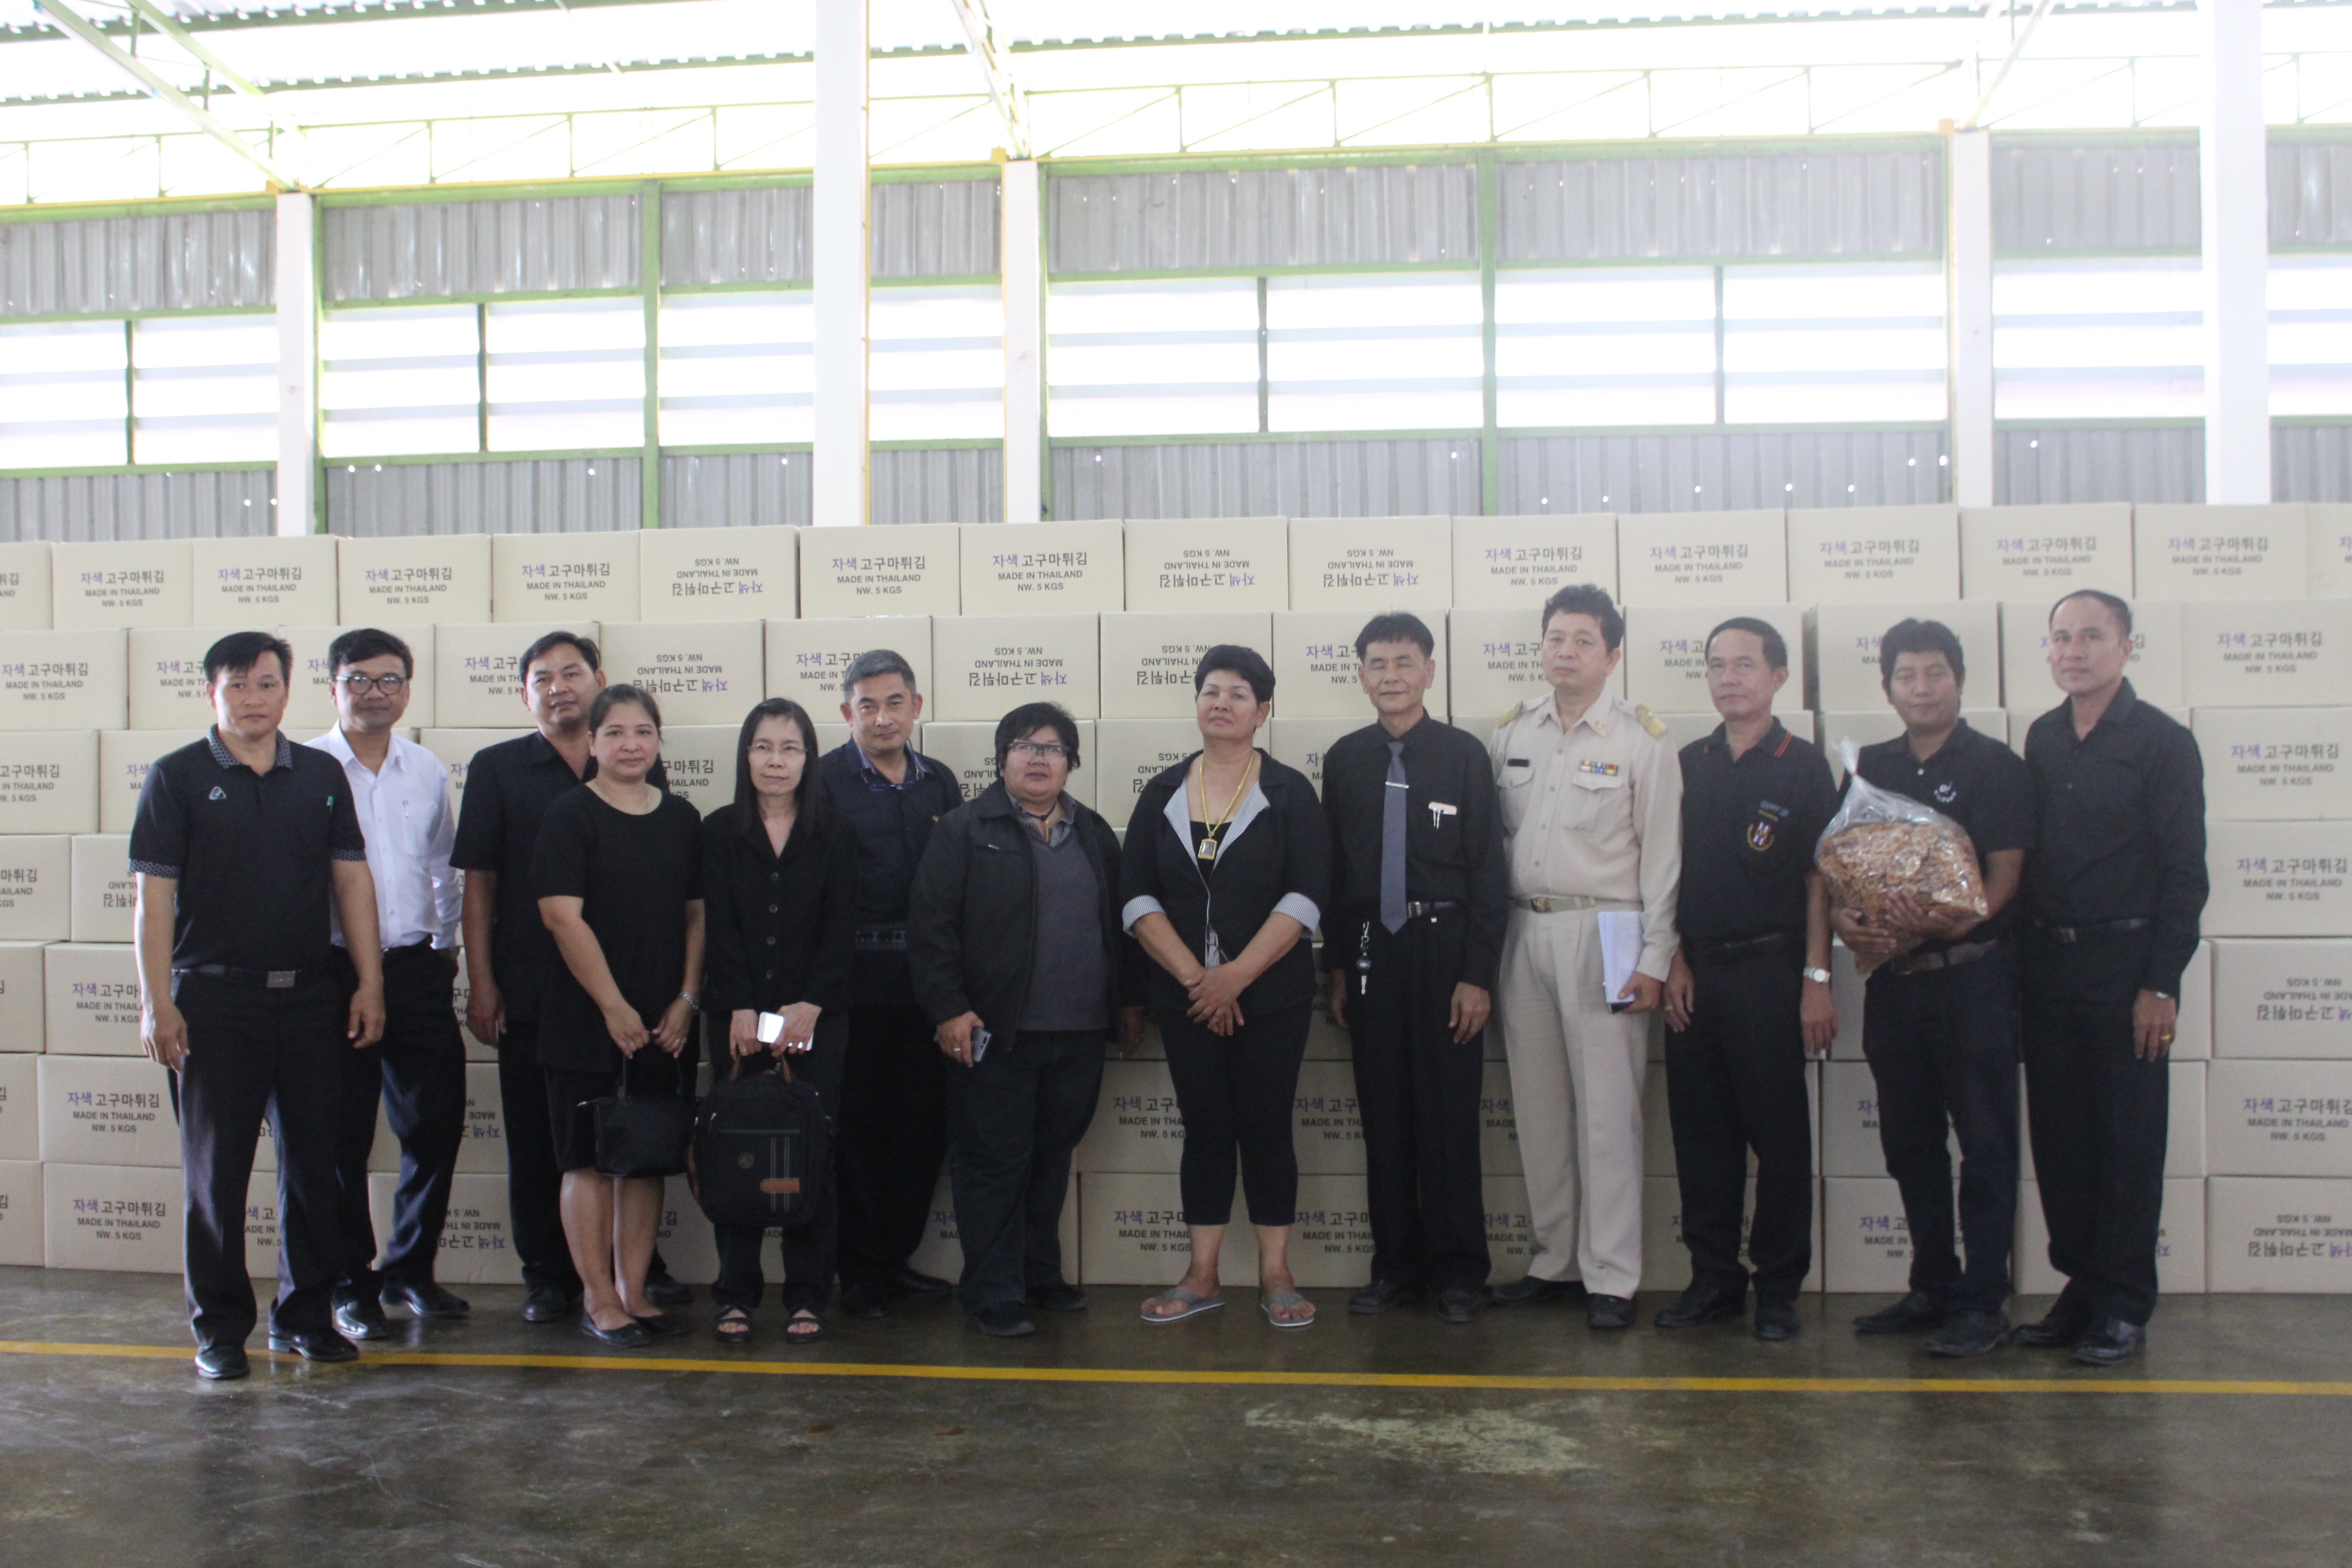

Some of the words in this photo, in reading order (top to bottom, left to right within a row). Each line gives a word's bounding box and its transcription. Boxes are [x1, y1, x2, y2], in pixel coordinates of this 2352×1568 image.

[1183, 550, 1203, 558] KGS
[1347, 549, 1367, 558] KGS
[1368, 549, 1374, 557] 5
[694, 559, 714, 567] KGS
[1163, 561, 1209, 570] THAILAND
[1224, 560, 1250, 568] MADE
[1327, 561, 1373, 570] THAILAND
[1388, 560, 1414, 568] MADE
[1654, 564, 1681, 572] MADE
[1696, 562, 1743, 571] THAILAND
[734, 568, 758, 576] MADE
[1490, 566, 1516, 574] MADE
[1531, 564, 1578, 573] THAILAND
[676, 570, 720, 578] THAILAND
[998, 572, 1023, 581] MADE
[1037, 570, 1083, 578] THAILAND
[1702, 574, 1722, 583] KGS
[836, 575, 862, 584] MADE
[876, 574, 921, 583] THAILAND
[1537, 576, 1558, 585] KGS
[257, 584, 297, 592] THAILAND
[369, 586, 393, 594] MADE
[406, 585, 447, 593] THAILAND
[526, 582, 550, 590] MADE
[564, 581, 606, 589] THAILAND
[875, 587, 881, 595] 5
[882, 585, 902, 594] KGS
[1037, 583, 1043, 591] 5
[1044, 582, 1064, 590] KGS
[84, 589, 108, 597] MADE
[120, 587, 161, 595] THAILAND
[569, 592, 588, 600] KGS
[125, 598, 144, 606] KGS
[261, 595, 279, 603] KGS
[411, 595, 429, 604] KGS
[994, 647, 1015, 656] KGS
[1017, 647, 1022, 655] 5
[656, 655, 676, 663] KGS
[974, 659, 1021, 668] THAILAND
[1036, 658, 1063, 667] MADE
[636, 666, 683, 675] THAILAND
[697, 665, 722, 674] MADE
[5, 681, 29, 689] MADE
[42, 681, 84, 689] THAILAND
[47, 691, 65, 700] KGS
[72, 1111, 97, 1120] MADE
[99, 1111, 110, 1120] IN
[111, 1111, 155, 1121] THAILAND
[110, 1124, 116, 1132] 5
[117, 1124, 137, 1133] KGS
[77, 1218, 102, 1226] MADE
[116, 1219, 161, 1229] THAILAND
[122, 1232, 142, 1240] KGS
[1119, 1230, 1147, 1238] MADE
[1150, 1230, 1160, 1238] IN
[1162, 1243, 1168, 1252] 5
[1171, 1243, 1191, 1252] KGS
